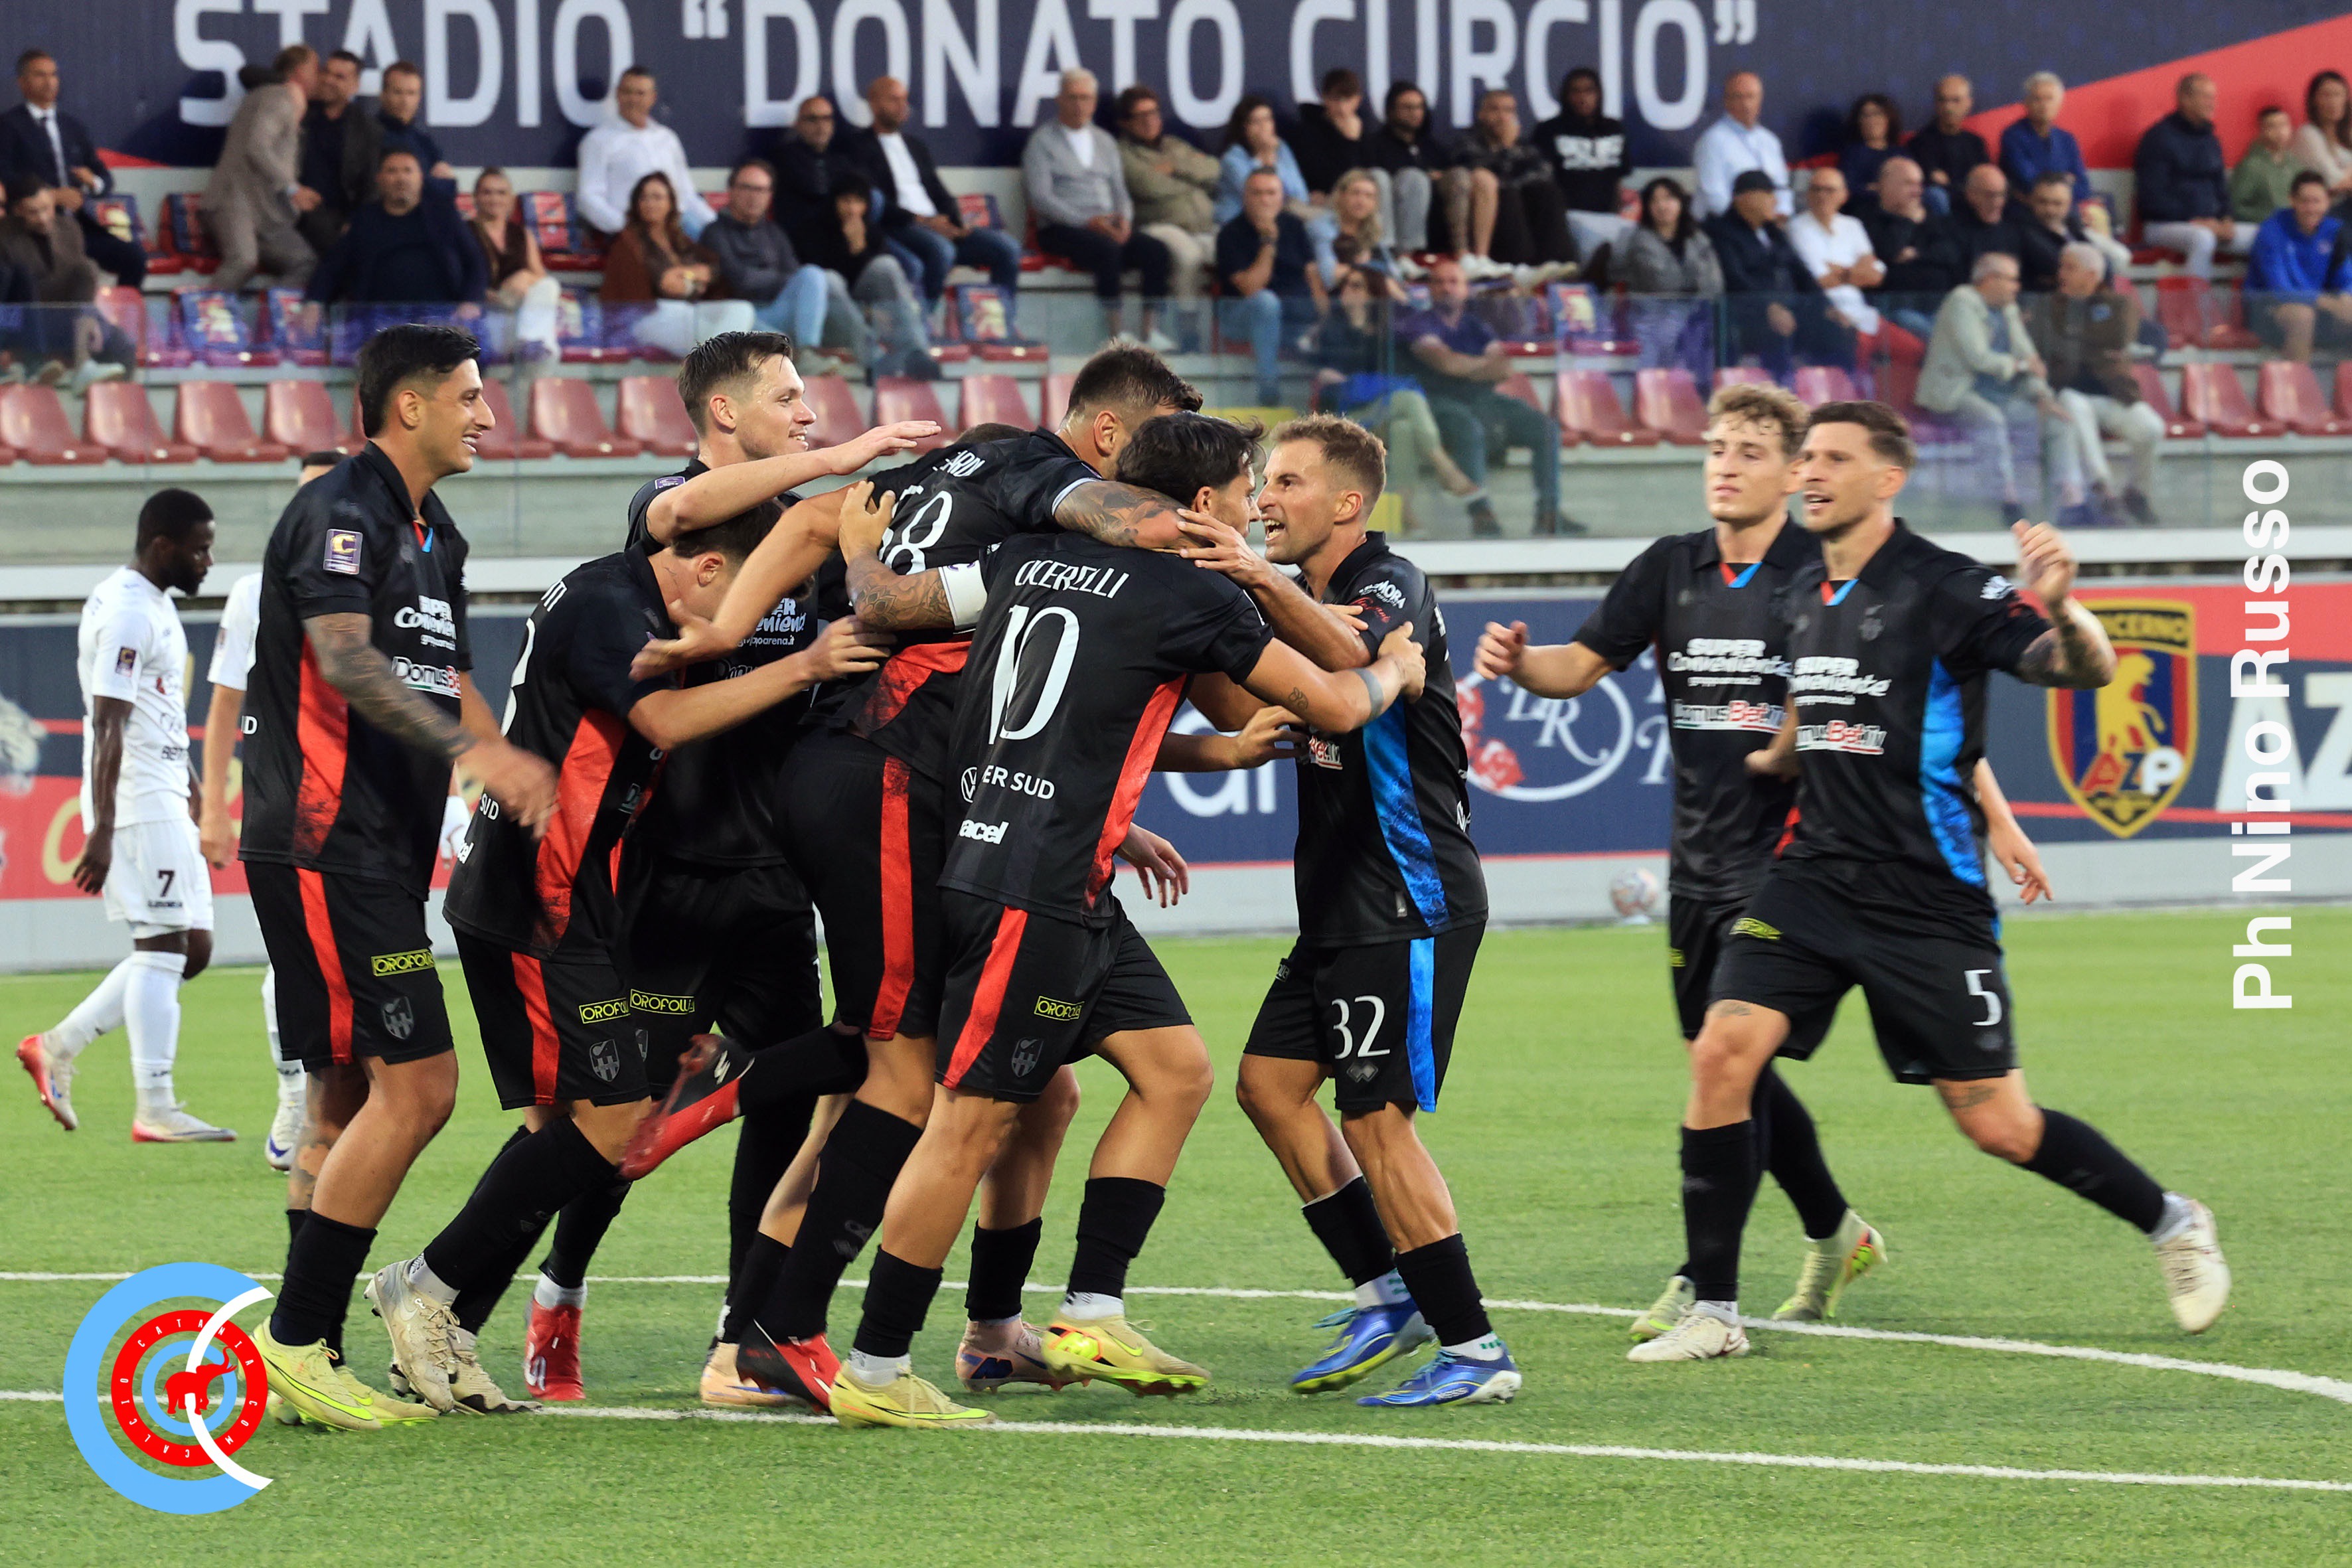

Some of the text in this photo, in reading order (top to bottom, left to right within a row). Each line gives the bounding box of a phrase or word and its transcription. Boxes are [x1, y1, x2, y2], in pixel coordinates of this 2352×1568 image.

[174, 0, 635, 127] STADIO
[1014, 560, 1129, 599] CICERELLI
[988, 604, 1080, 745] 10
[1010, 772, 1055, 799] SUD
[958, 819, 1009, 844] acel
[157, 870, 175, 898] 7
[1964, 969, 2001, 1026] 5
[1332, 995, 1390, 1059] 32
